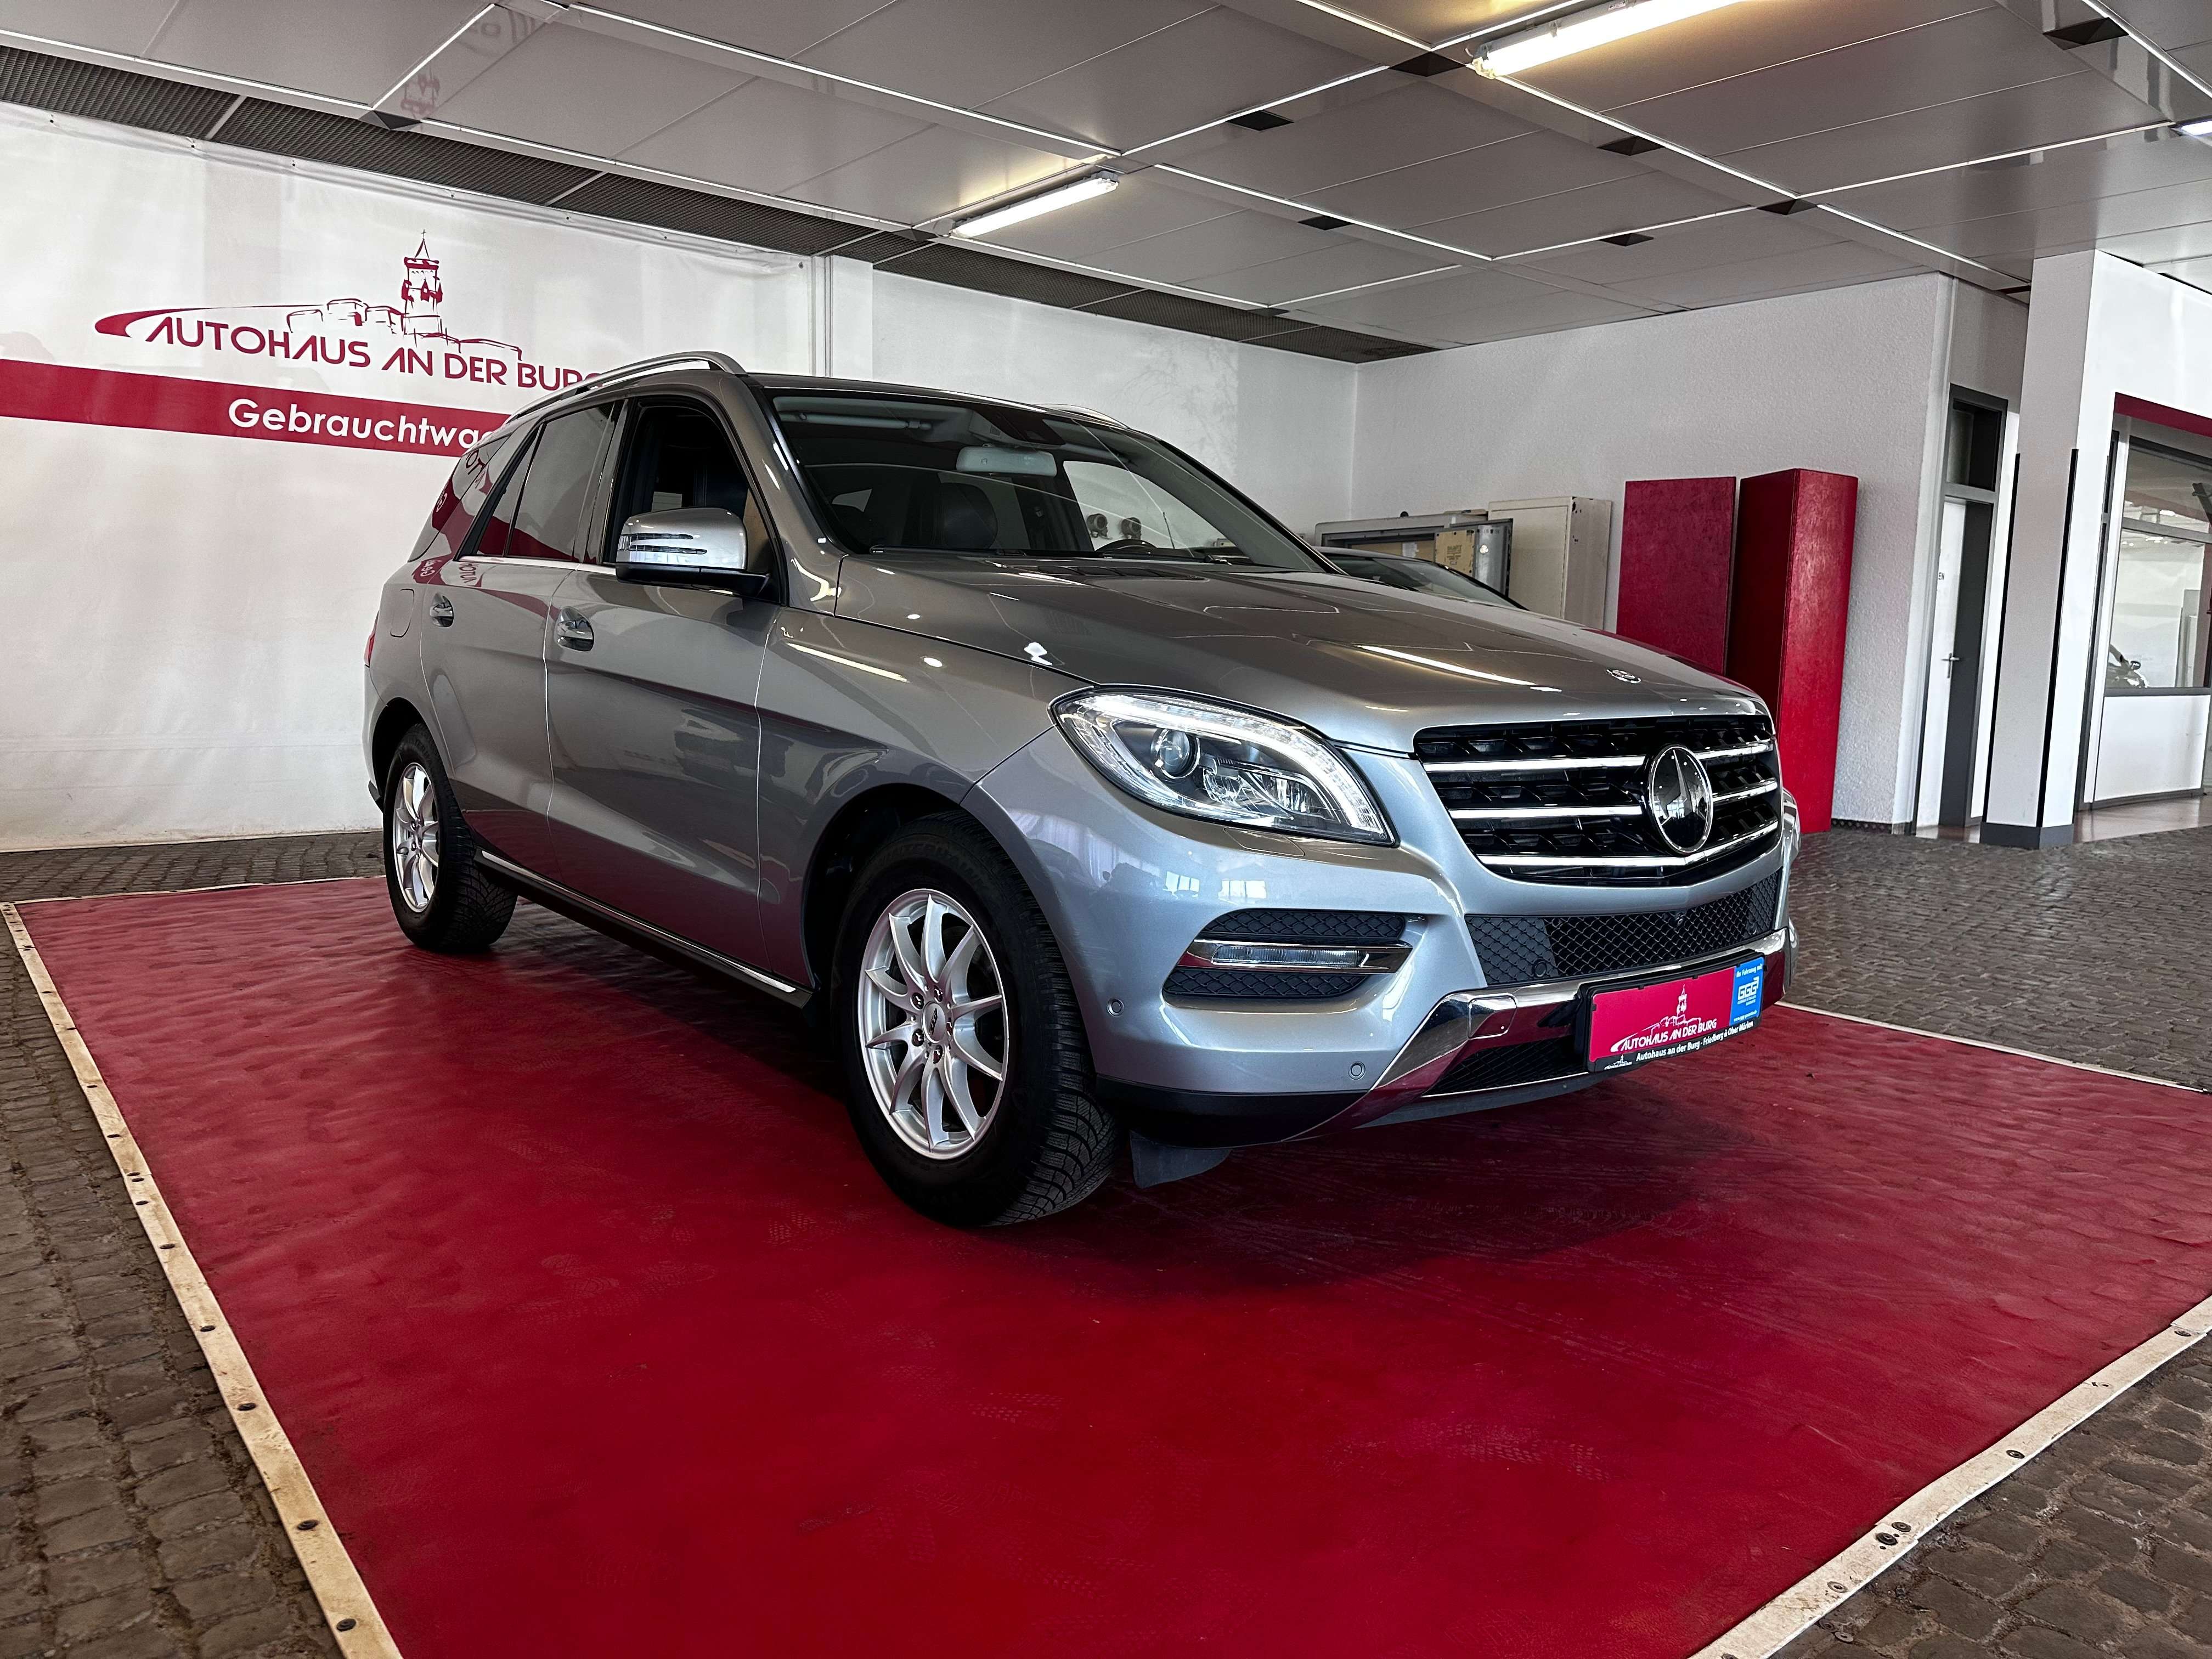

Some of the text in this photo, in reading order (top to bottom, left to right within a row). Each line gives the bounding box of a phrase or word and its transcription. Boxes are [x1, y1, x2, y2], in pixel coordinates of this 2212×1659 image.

[145, 316, 602, 391] AUTOHAUS AN DER BUR
[228, 398, 496, 448] Gebrauchtwa
[1737, 980, 1758, 1001] GGG
[1620, 1018, 1717, 1052] AUTOHAUS AN DER BURG
[1635, 1048, 1667, 1062] Autohaus
[1667, 1047, 1675, 1055] an
[1676, 1043, 1687, 1053] der
[1687, 1041, 1700, 1051] Burg
[1702, 1031, 1724, 1046] Friedberg
